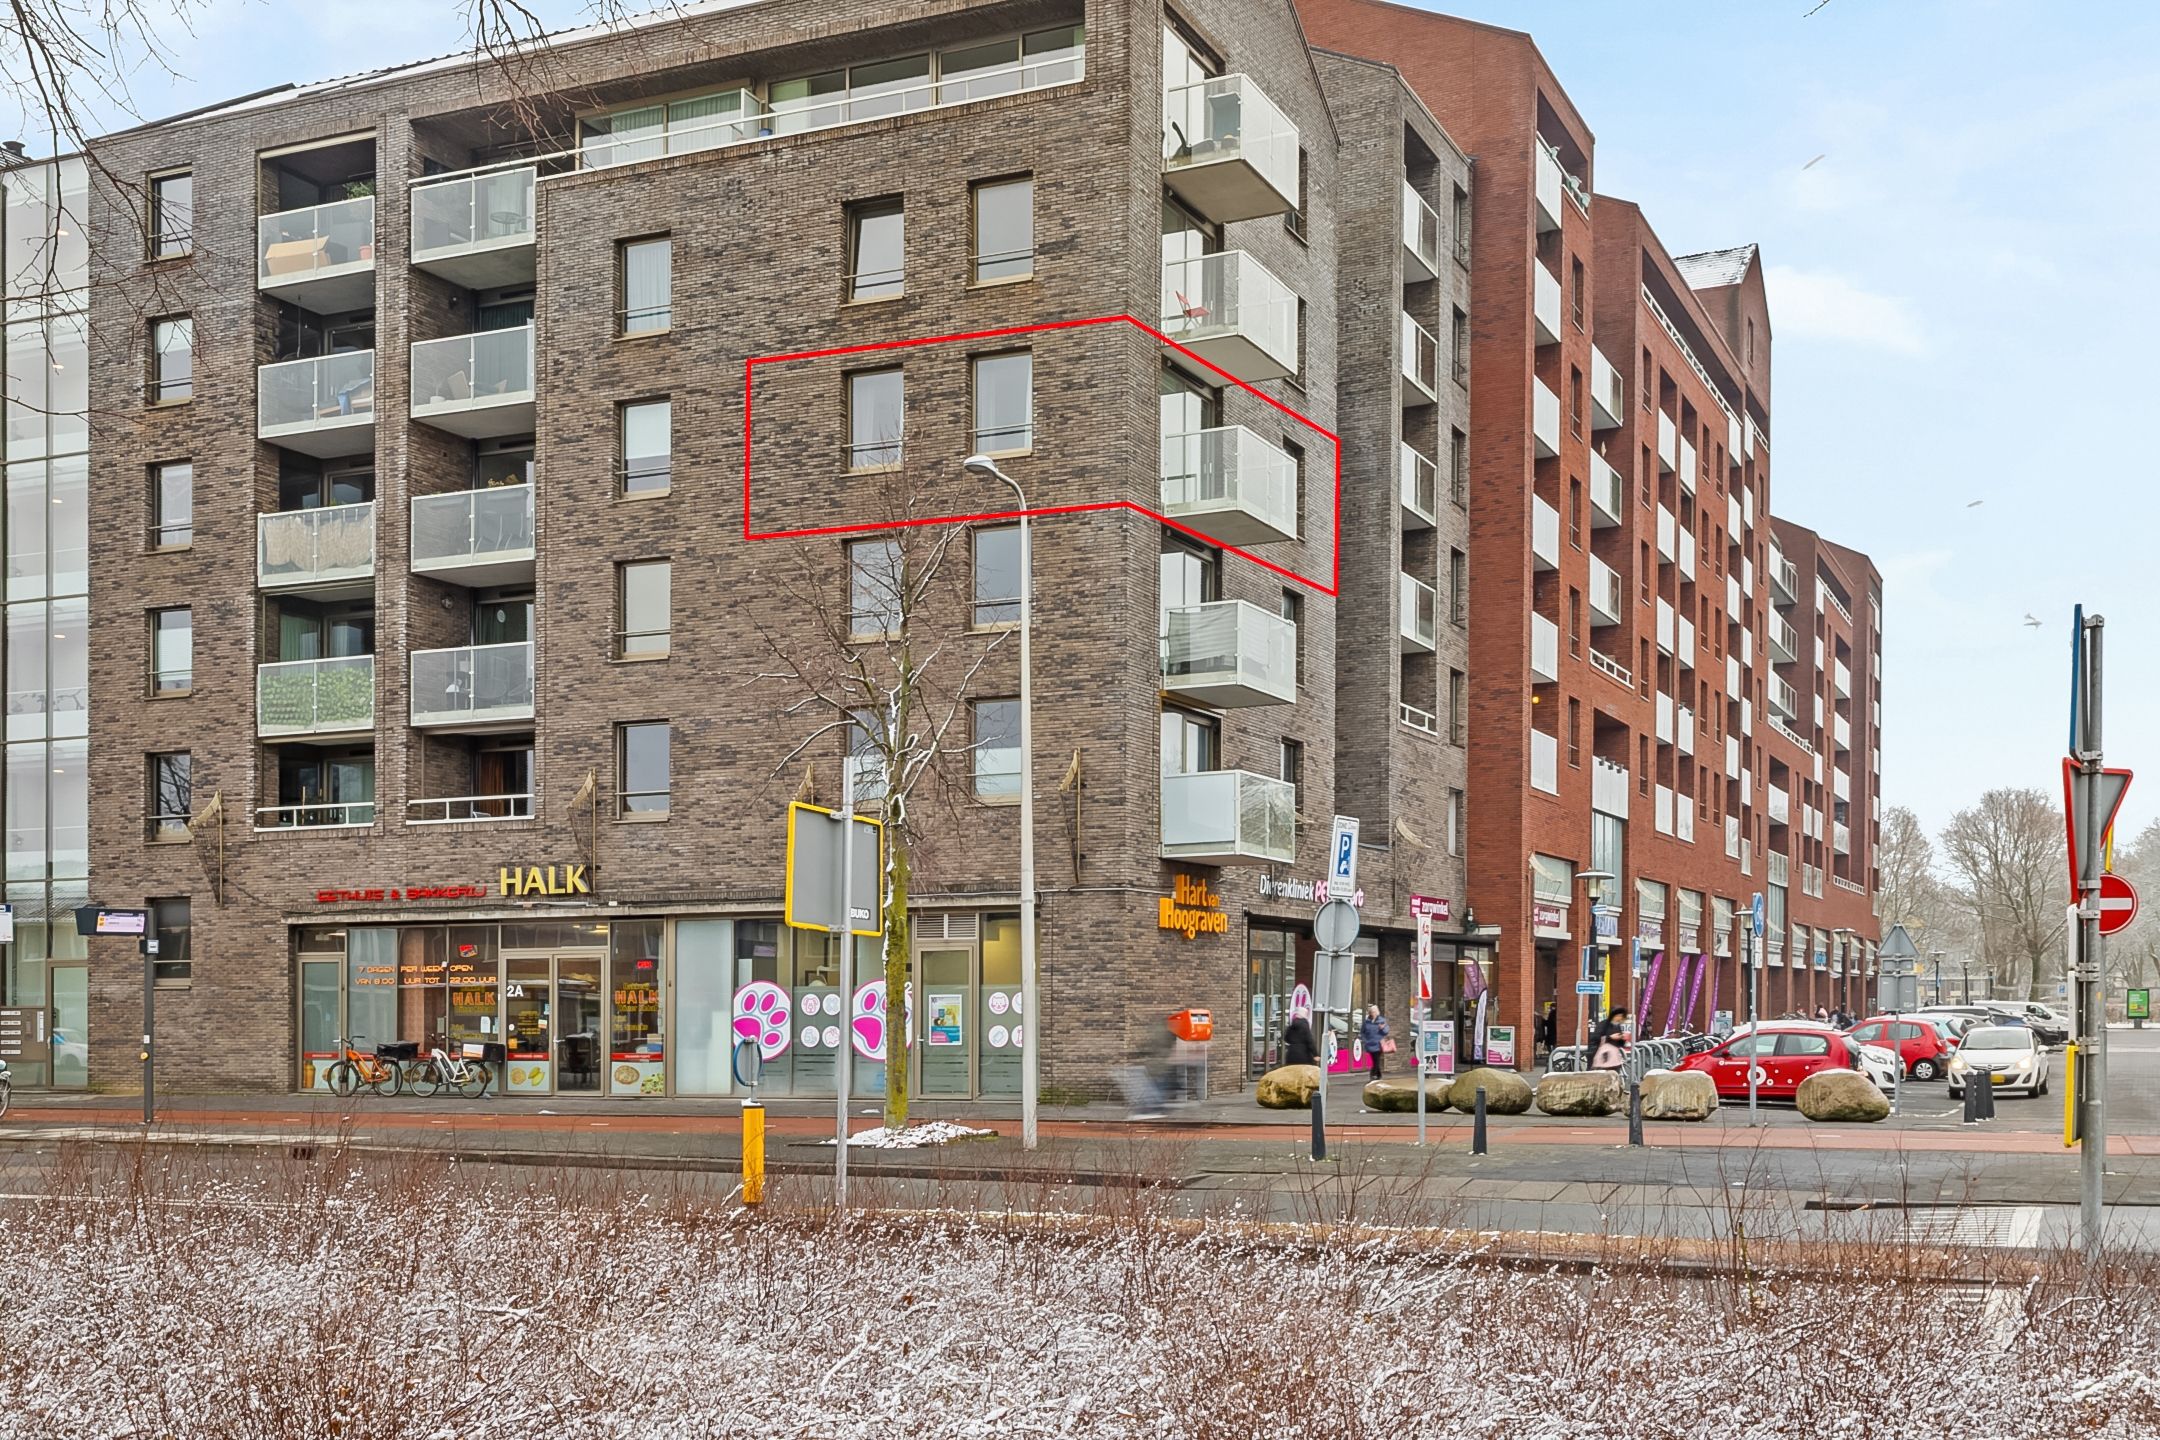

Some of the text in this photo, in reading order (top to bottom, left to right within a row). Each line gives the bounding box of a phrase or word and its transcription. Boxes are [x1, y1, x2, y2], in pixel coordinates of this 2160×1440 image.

[1341, 836, 1350, 858] P
[500, 864, 590, 896] HALK
[1260, 874, 1314, 901] Dierenkliniek
[317, 886, 487, 902] EETHUIS & BAKKERIJ
[1176, 873, 1207, 907] Hart
[850, 907, 870, 919] BUKO
[1159, 897, 1228, 939] Hoograven
[367, 966, 395, 974] DAGEN
[400, 965, 417, 973] PER
[420, 965, 444, 973] WEEK
[452, 991, 496, 1006] HALK
[507, 984, 524, 997] 2A
[614, 989, 659, 1005] HALK
